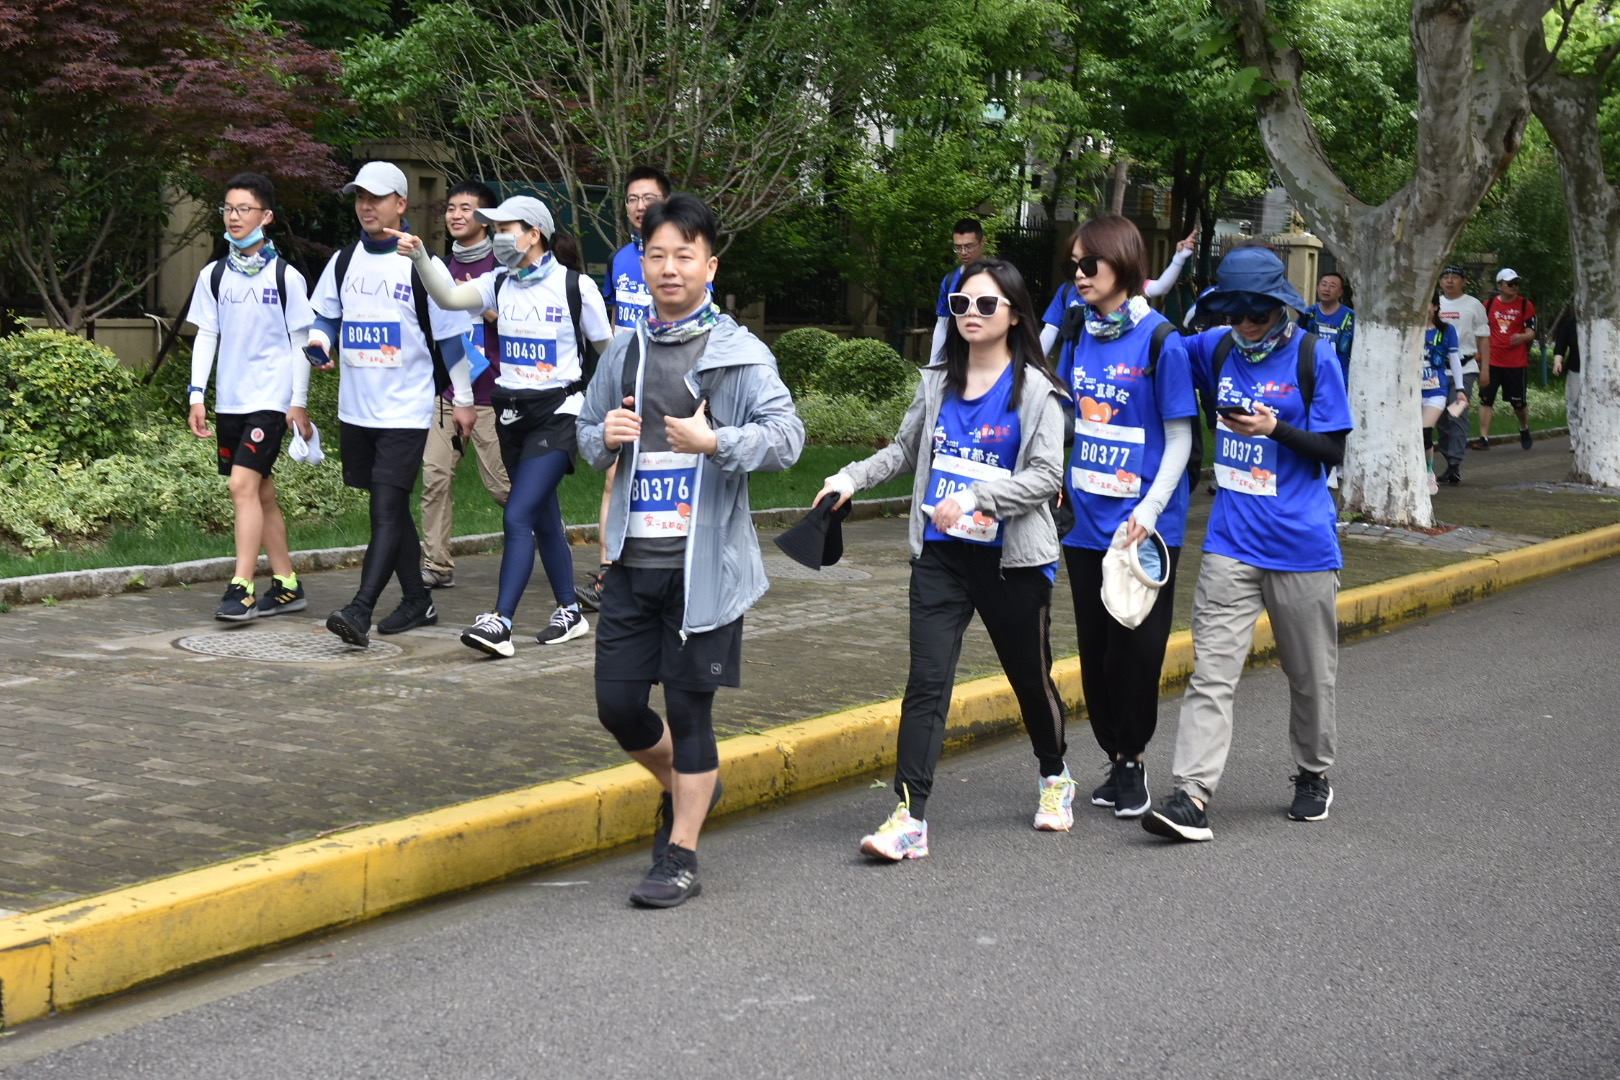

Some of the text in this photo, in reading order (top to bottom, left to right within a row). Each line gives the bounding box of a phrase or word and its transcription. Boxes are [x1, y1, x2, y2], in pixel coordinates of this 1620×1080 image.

[345, 276, 390, 298] KLA
[348, 326, 389, 343] B0431
[505, 341, 546, 360] B0430
[1081, 440, 1131, 467] B0377
[1222, 437, 1264, 465] B0373
[632, 476, 690, 501] B0376
